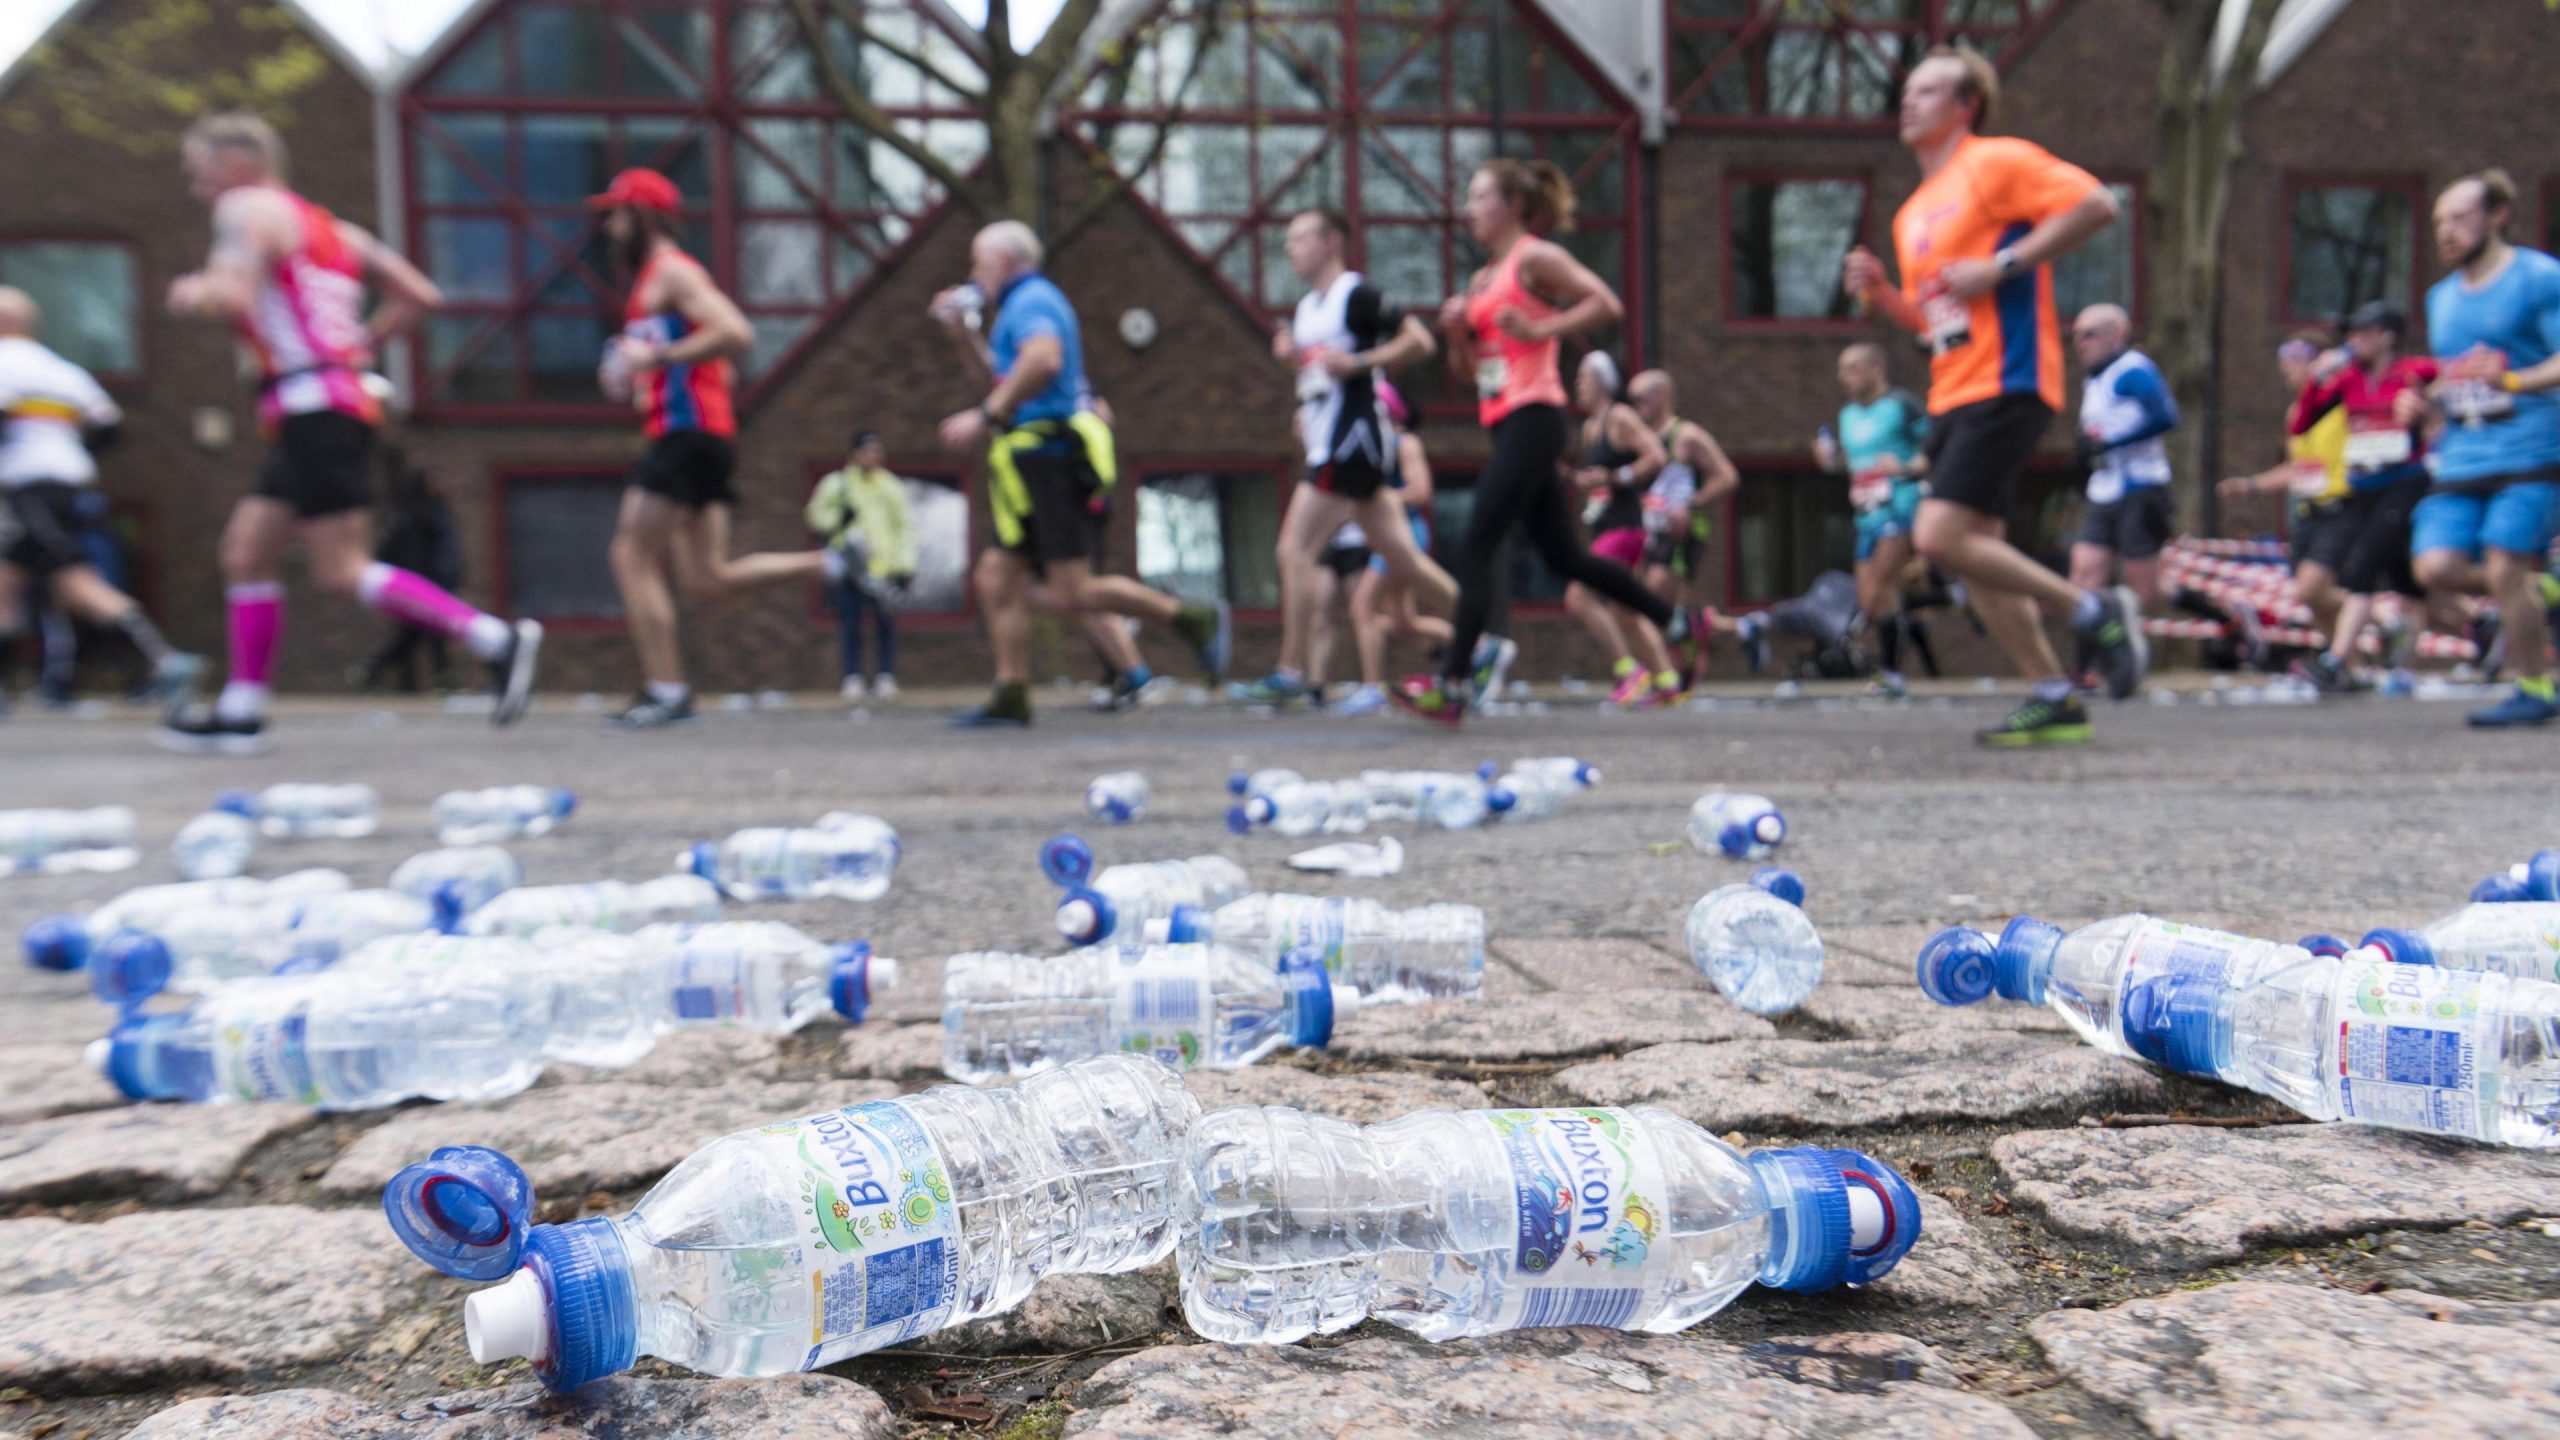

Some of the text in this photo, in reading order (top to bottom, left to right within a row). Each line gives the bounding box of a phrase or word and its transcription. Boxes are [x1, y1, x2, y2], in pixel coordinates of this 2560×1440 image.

[809, 1113, 890, 1207] Buxton
[1550, 1118, 1612, 1234] Buxton
[1521, 1208, 1532, 1237] WATER
